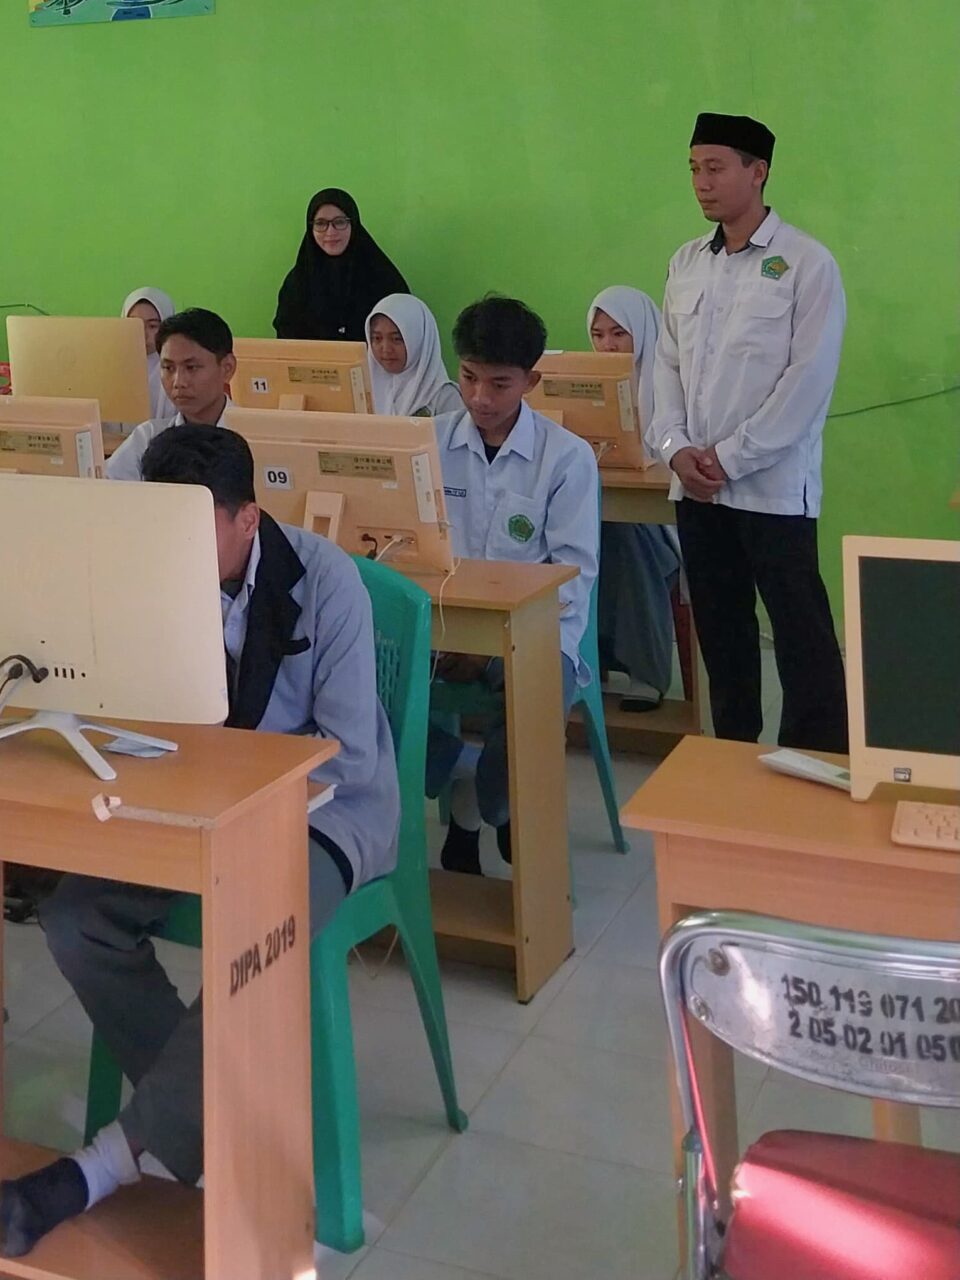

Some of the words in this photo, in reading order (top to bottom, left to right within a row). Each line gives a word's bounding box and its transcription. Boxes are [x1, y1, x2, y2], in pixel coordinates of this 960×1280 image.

[253, 380, 267, 391] 11
[267, 470, 288, 484] 09
[230, 942, 262, 997] DIPA
[265, 914, 296, 969] 2019
[781, 974, 822, 1007] 150
[880, 993, 925, 1022] 071
[788, 1009, 803, 1038] 2
[809, 1017, 837, 1046] 05
[843, 1024, 873, 1054] 02
[880, 1031, 908, 1058] 01
